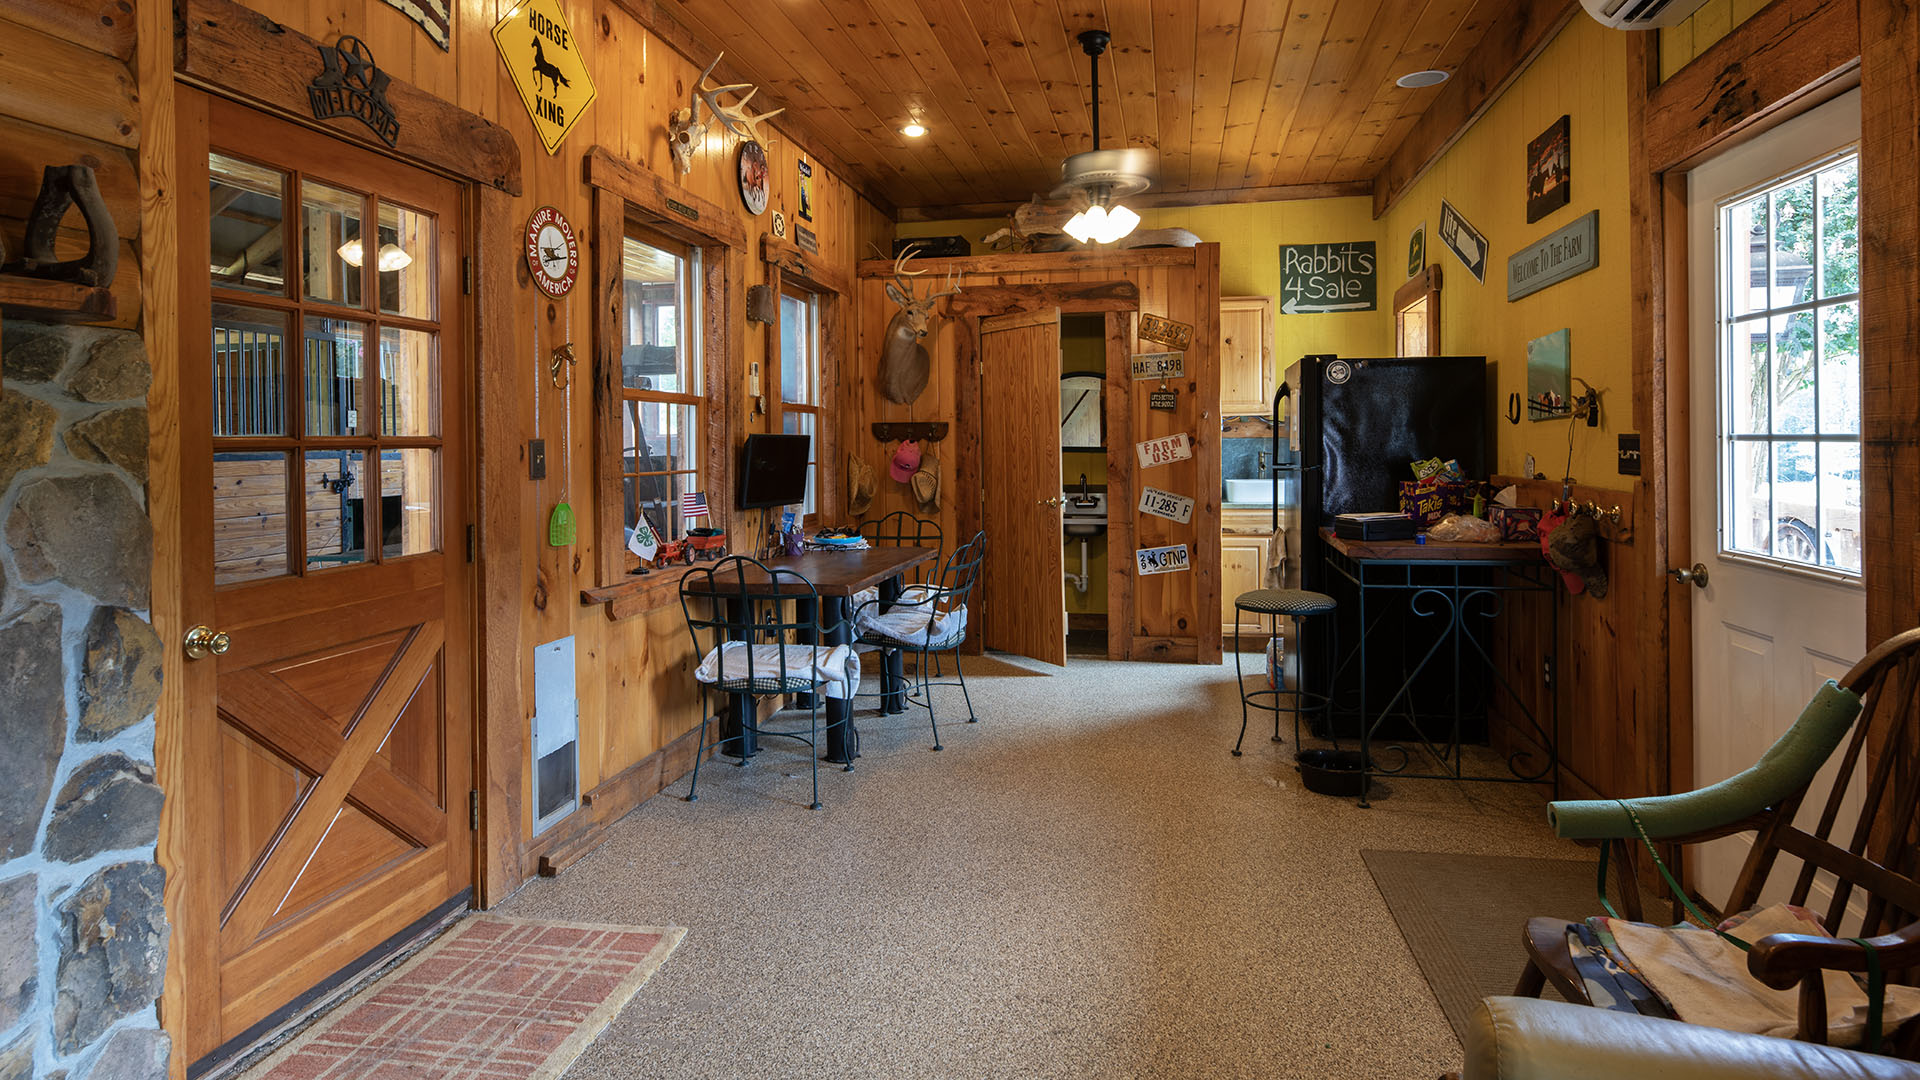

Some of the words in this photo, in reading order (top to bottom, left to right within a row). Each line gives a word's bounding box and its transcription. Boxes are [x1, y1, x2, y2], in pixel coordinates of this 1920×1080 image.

[529, 8, 569, 51] HORSE
[307, 86, 400, 148] WELCOME
[535, 94, 564, 127] XING
[529, 209, 552, 257] MANURE
[555, 213, 577, 267] MOVERS
[1285, 243, 1374, 275] Rabbits
[1512, 256, 1539, 284] WELCOME
[1563, 234, 1582, 261] FARM
[536, 270, 573, 294] AMERICA
[1285, 276, 1304, 301] 4
[1305, 275, 1362, 299] Sale
[1133, 361, 1151, 374] HAF
[1143, 438, 1182, 455] FARM
[1152, 449, 1178, 463] USE
[1144, 494, 1178, 514] 11-285
[1182, 504, 1191, 517] F
[1417, 498, 1443, 516] Takis
[1427, 510, 1441, 521] MIX
[1159, 549, 1187, 566] GTNP
